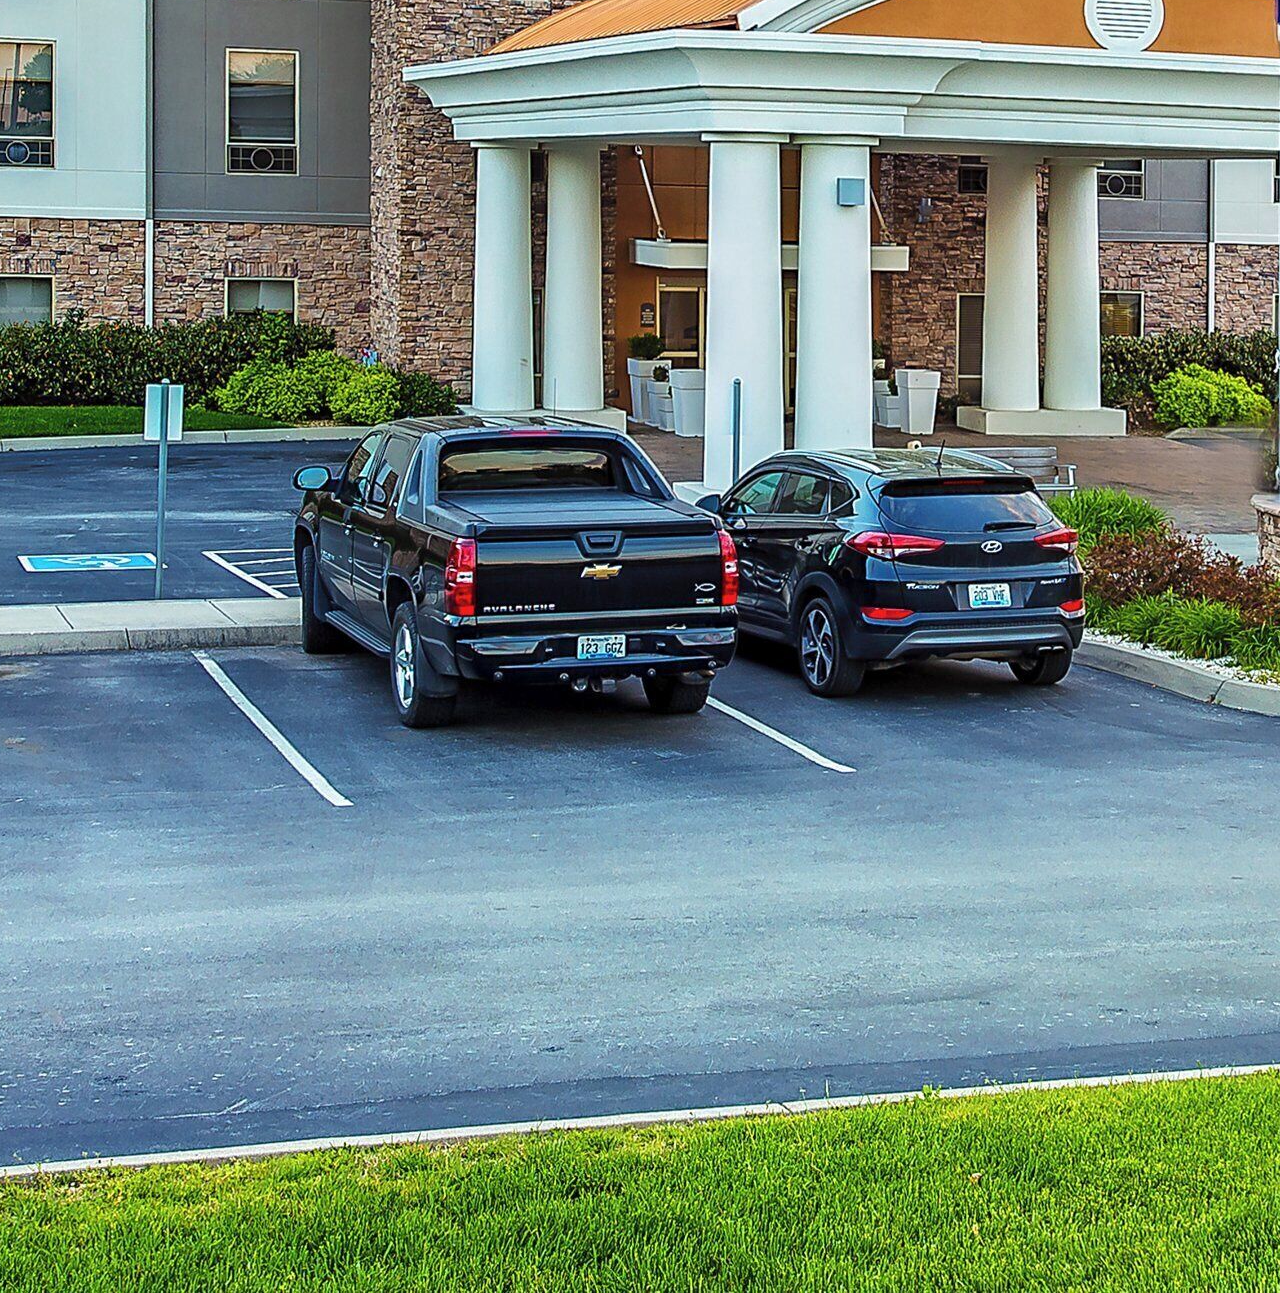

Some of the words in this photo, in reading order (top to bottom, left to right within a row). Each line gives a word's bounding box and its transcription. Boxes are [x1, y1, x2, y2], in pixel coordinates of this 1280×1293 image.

[973, 589, 989, 602] 203
[483, 603, 556, 613] AVALANCHE
[580, 642, 599, 655] 123
[604, 641, 624, 654] GGZ
